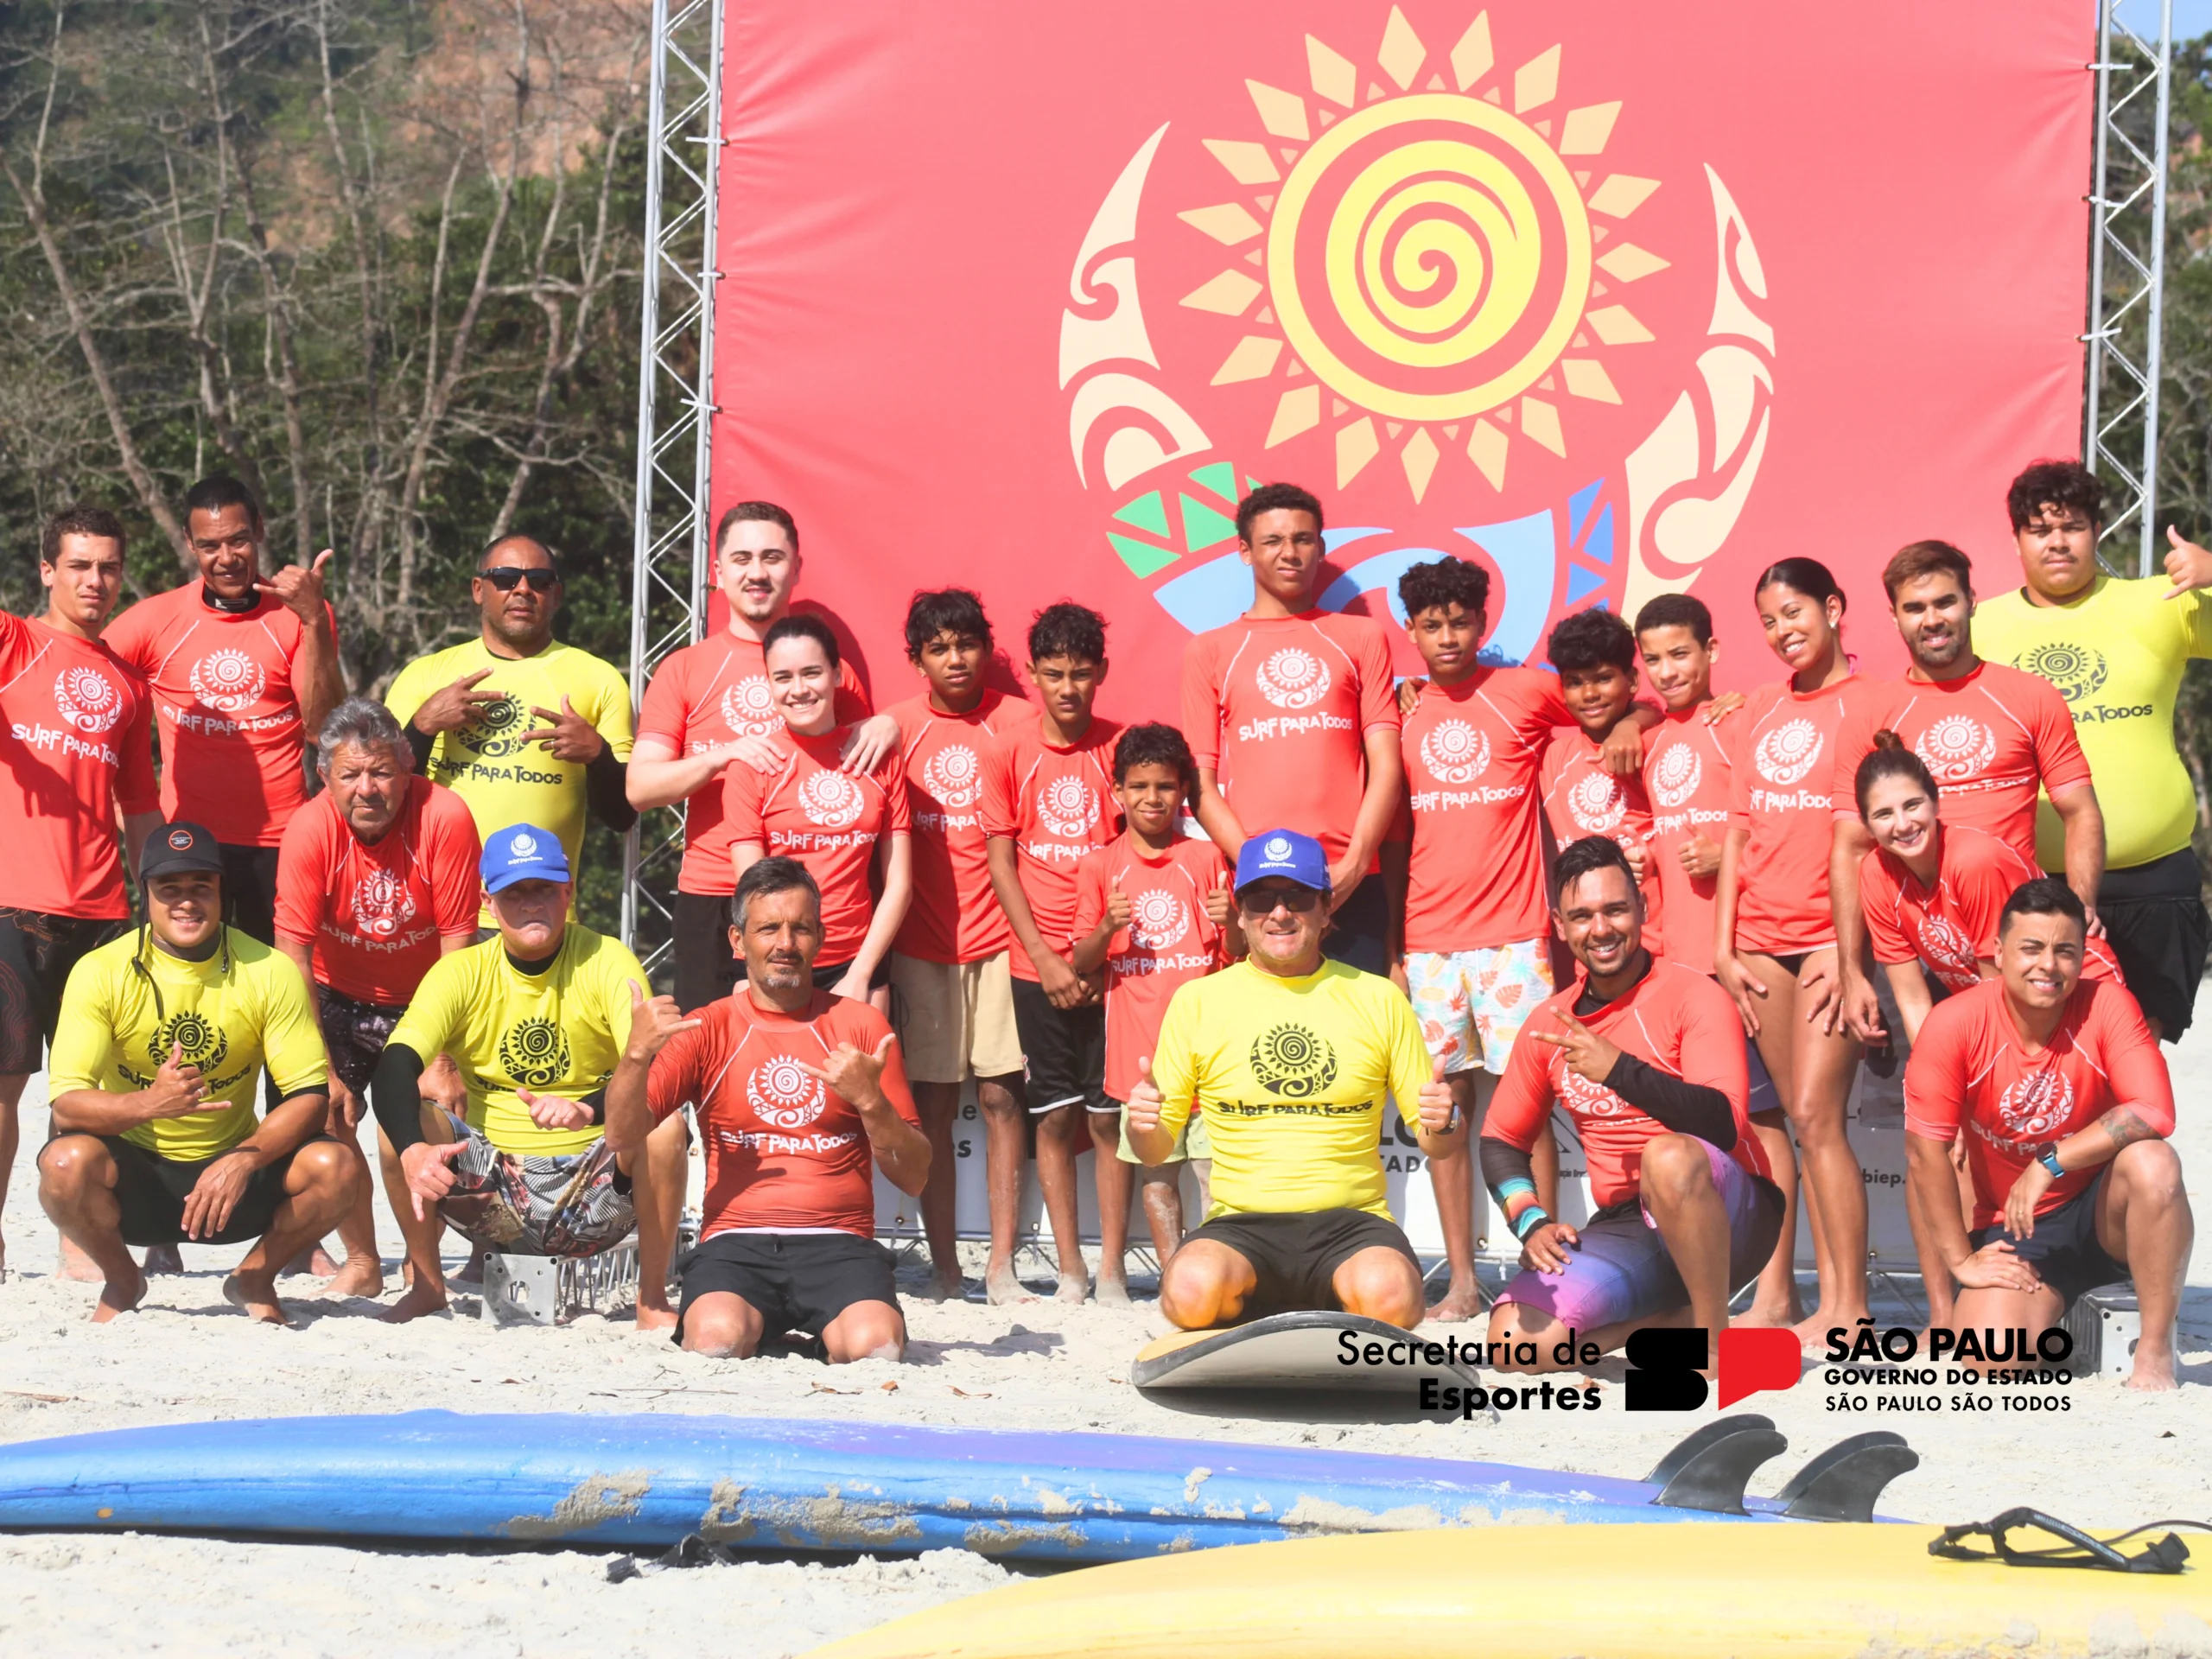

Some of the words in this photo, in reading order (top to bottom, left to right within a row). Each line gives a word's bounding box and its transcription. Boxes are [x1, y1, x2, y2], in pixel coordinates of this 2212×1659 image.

[205, 718, 250, 736] PARA
[249, 709, 294, 732] TODOS
[2071, 711, 2095, 722] RA
[2094, 704, 2153, 723] TODOS
[1239, 718, 1278, 741] SURF
[1280, 715, 1321, 737] PARA
[1319, 711, 1352, 729] TODOS
[11, 722, 63, 750] SURF
[62, 734, 99, 760] PARA
[471, 764, 513, 783] PARA
[513, 766, 563, 784] TODOS
[1441, 791, 1481, 811] PARA
[1479, 785, 1525, 804] TODOS
[1765, 791, 1796, 812] PARA
[1797, 789, 1832, 810] TODO
[940, 814, 977, 832] PARA
[770, 830, 813, 849] SURF
[814, 834, 851, 850] PARA
[851, 830, 879, 847] TODO
[1054, 843, 1090, 861] PARA
[321, 921, 362, 948] SURF
[365, 938, 410, 954] PARA
[405, 926, 437, 945] TOD
[1111, 955, 1138, 976] SURF
[1140, 957, 1176, 976] PARA
[118, 1064, 156, 1090] SUR
[1273, 1104, 1322, 1115] PARA
[768, 1134, 815, 1154] PARA
[810, 1132, 858, 1154] TODOS
